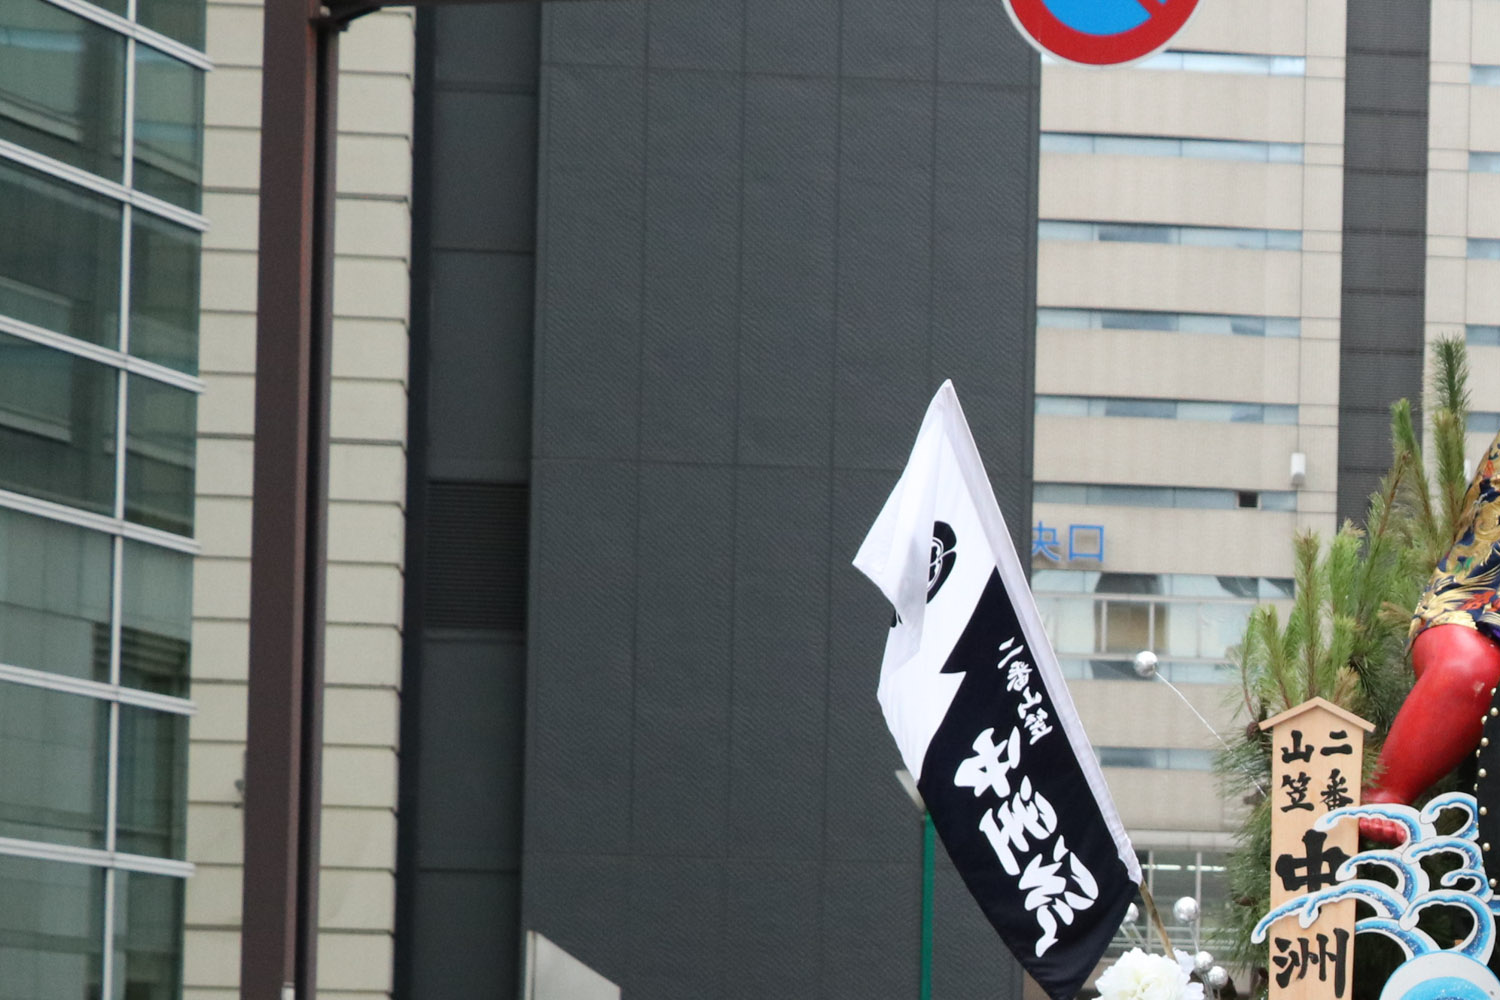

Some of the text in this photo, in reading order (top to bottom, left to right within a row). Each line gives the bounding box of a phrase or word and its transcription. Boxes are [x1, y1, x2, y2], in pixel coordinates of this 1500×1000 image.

[954, 726, 1099, 957] 中洲流
[1280, 730, 1315, 813] 山笠
